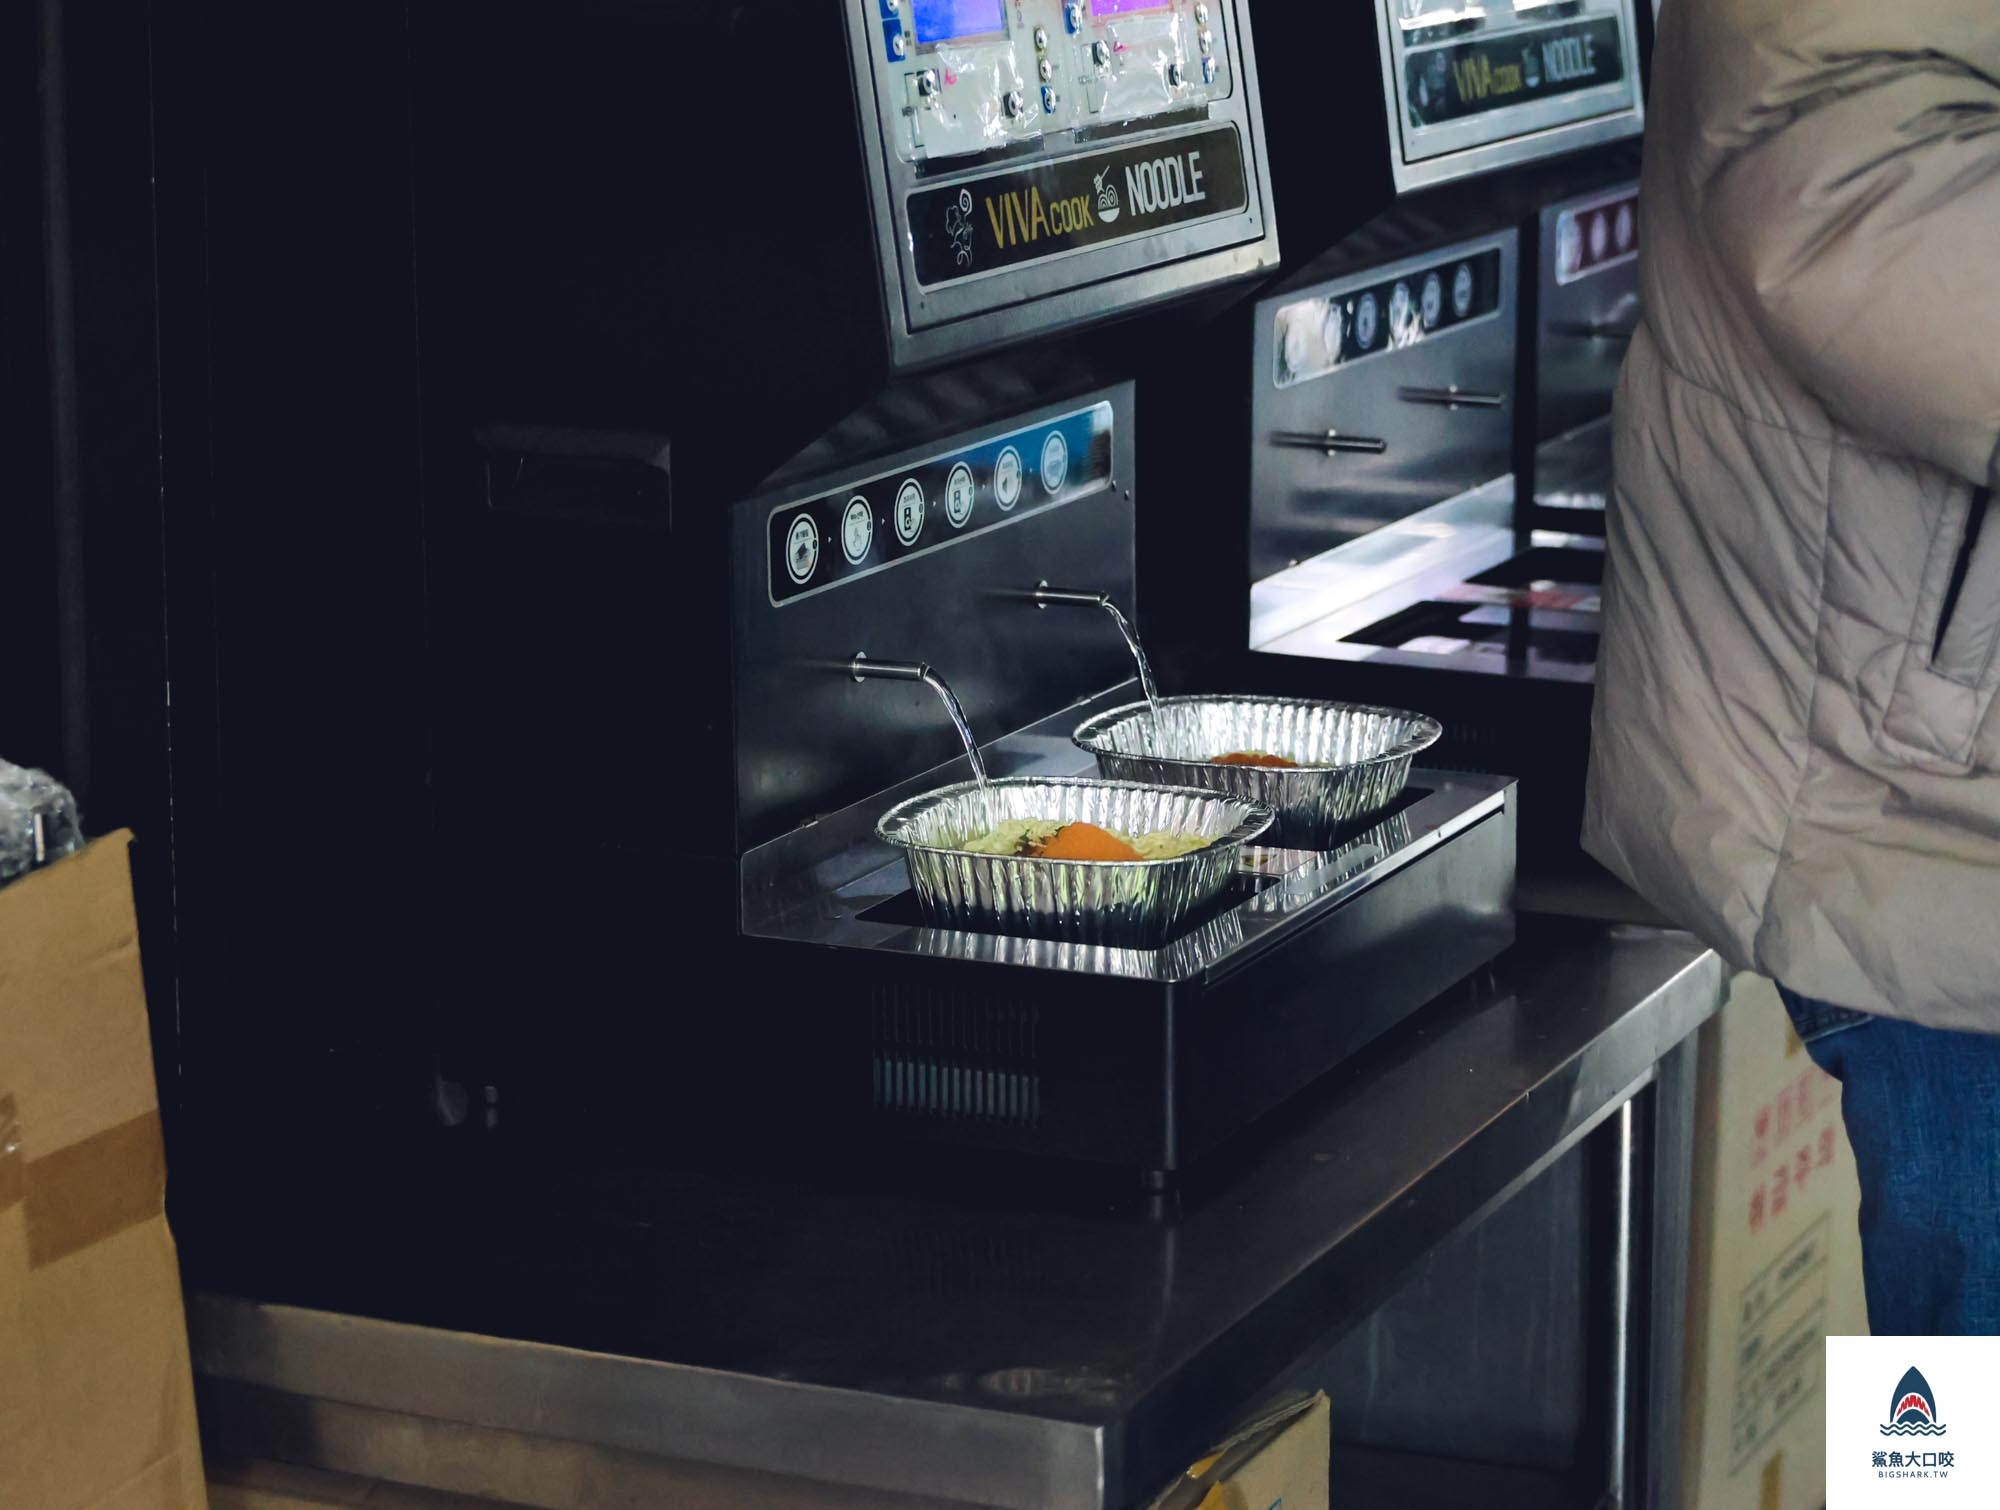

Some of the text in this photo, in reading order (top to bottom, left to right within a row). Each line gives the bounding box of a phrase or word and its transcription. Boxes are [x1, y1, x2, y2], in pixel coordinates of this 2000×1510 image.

[986, 151, 1207, 249] VIVA COOK NOODLE
